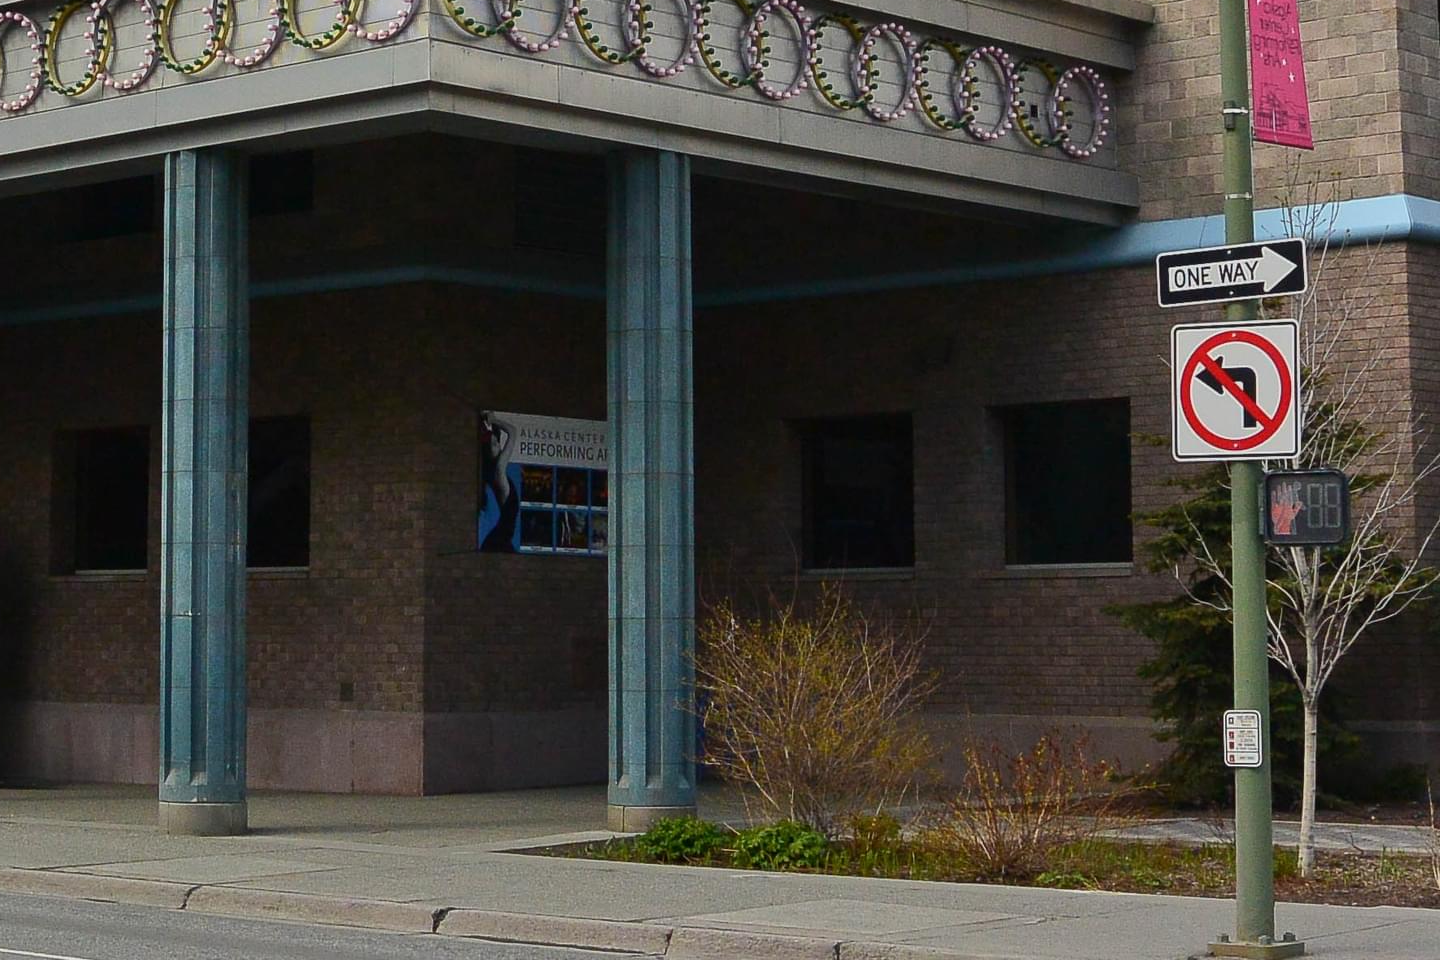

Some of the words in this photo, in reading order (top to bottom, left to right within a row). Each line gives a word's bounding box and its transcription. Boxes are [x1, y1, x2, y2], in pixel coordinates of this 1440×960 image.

[1174, 266, 1212, 288] ONE
[1219, 260, 1258, 284] WAY
[520, 428, 561, 441] ALASKA
[563, 431, 605, 444] CENTER
[520, 442, 594, 461] PERFORMING
